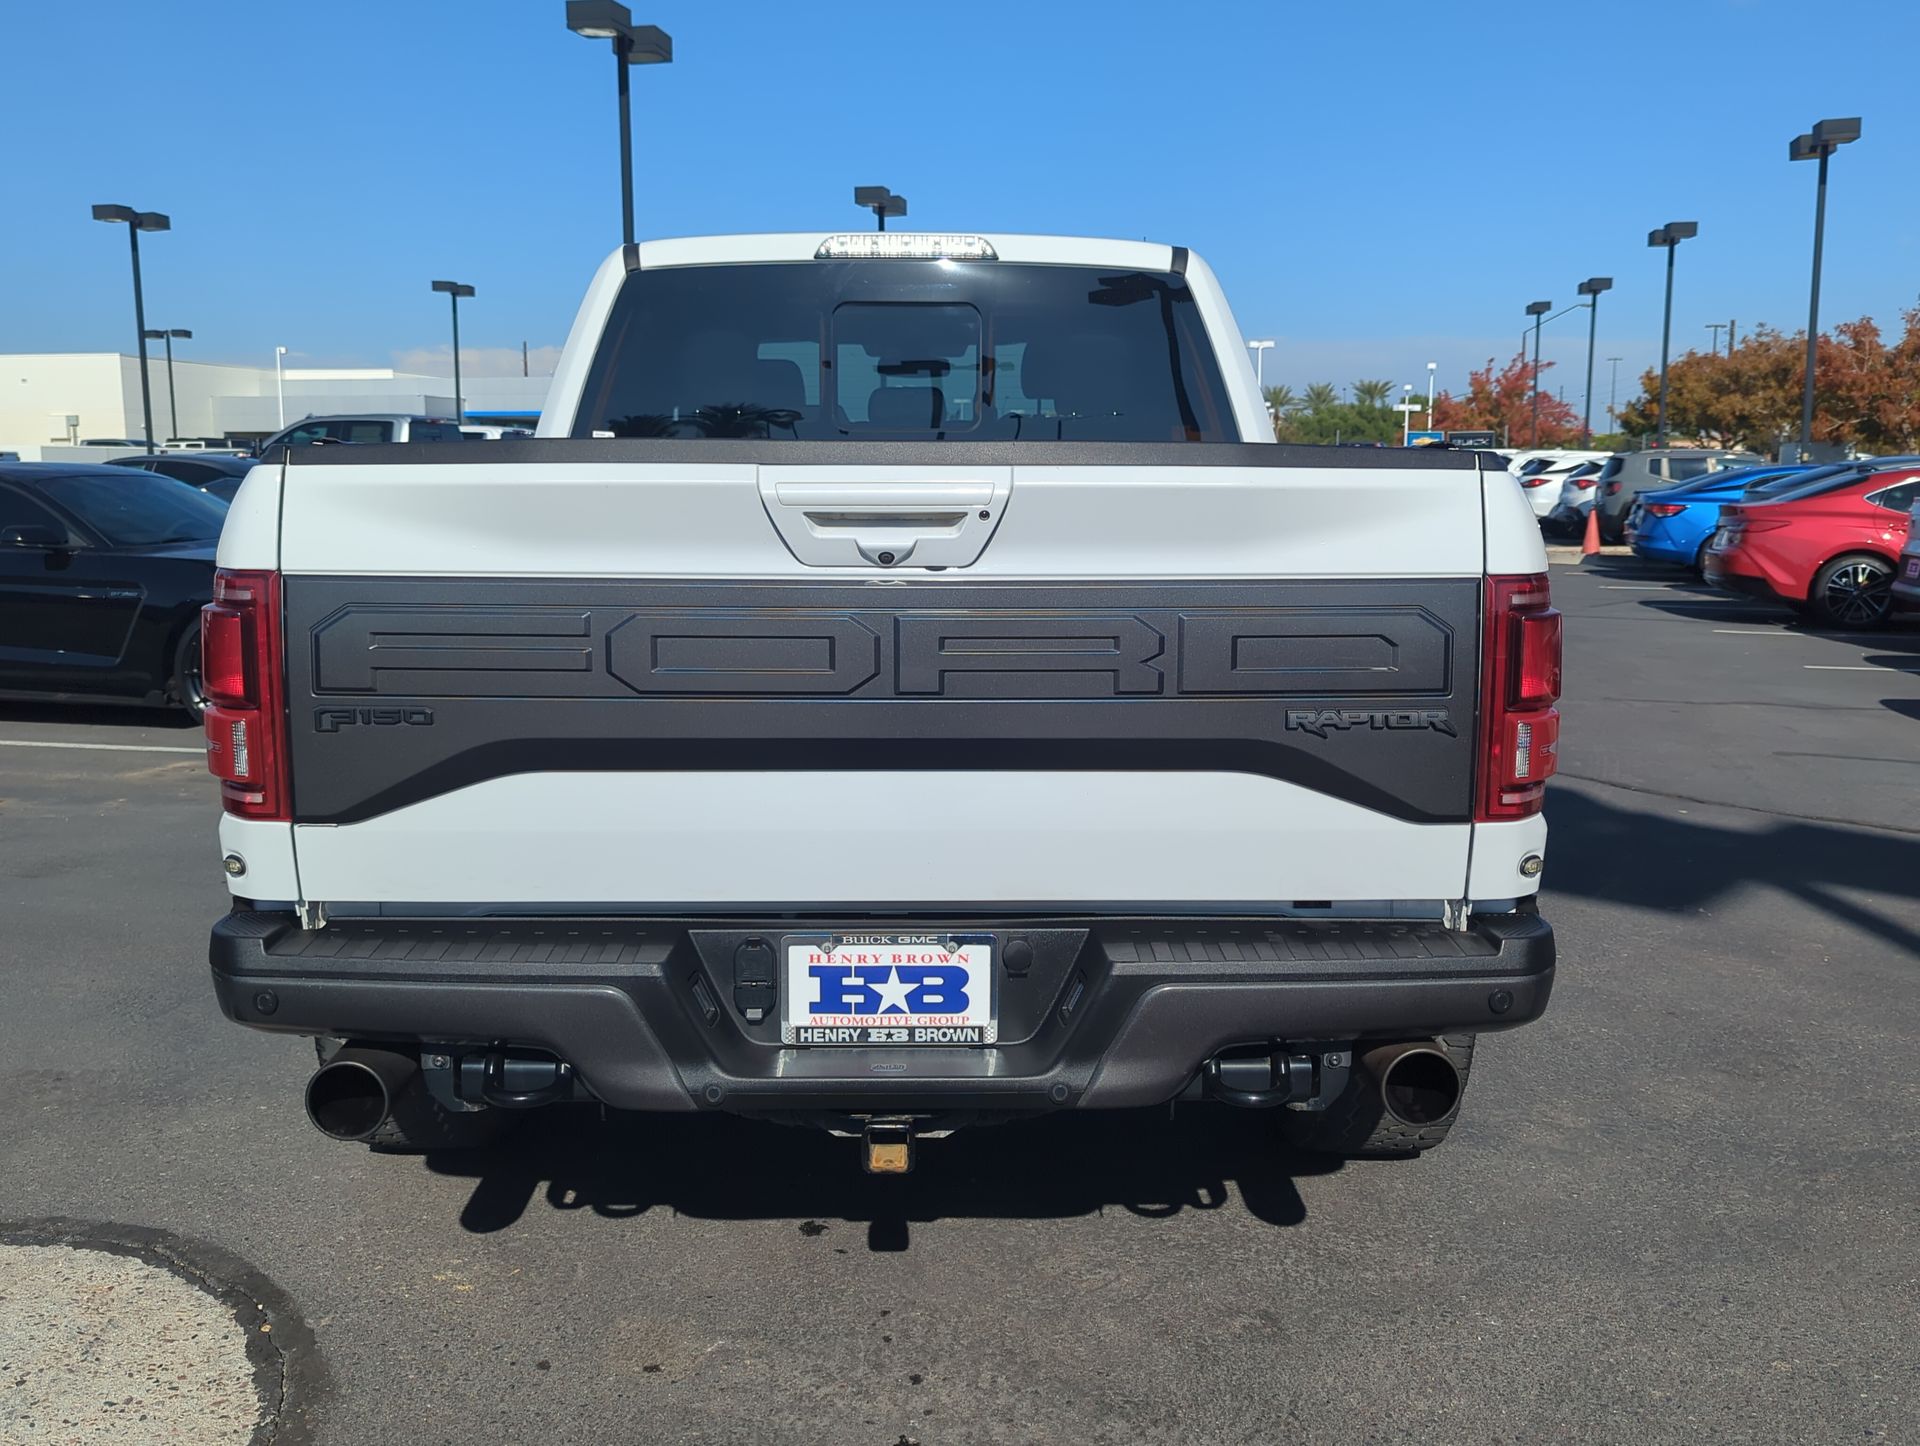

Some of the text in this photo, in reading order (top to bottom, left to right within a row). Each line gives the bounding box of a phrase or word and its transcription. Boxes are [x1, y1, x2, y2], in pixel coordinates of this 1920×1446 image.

[311, 604, 1453, 695] FORD
[1285, 709, 1457, 739] RAPTOR
[842, 936, 891, 944] BUICK
[809, 954, 970, 964] HENRY BROWN
[810, 1016, 970, 1026] AUTOMOTIVE GROUP
[800, 1028, 861, 1042] HENRY
[915, 1028, 979, 1042] BROWN
